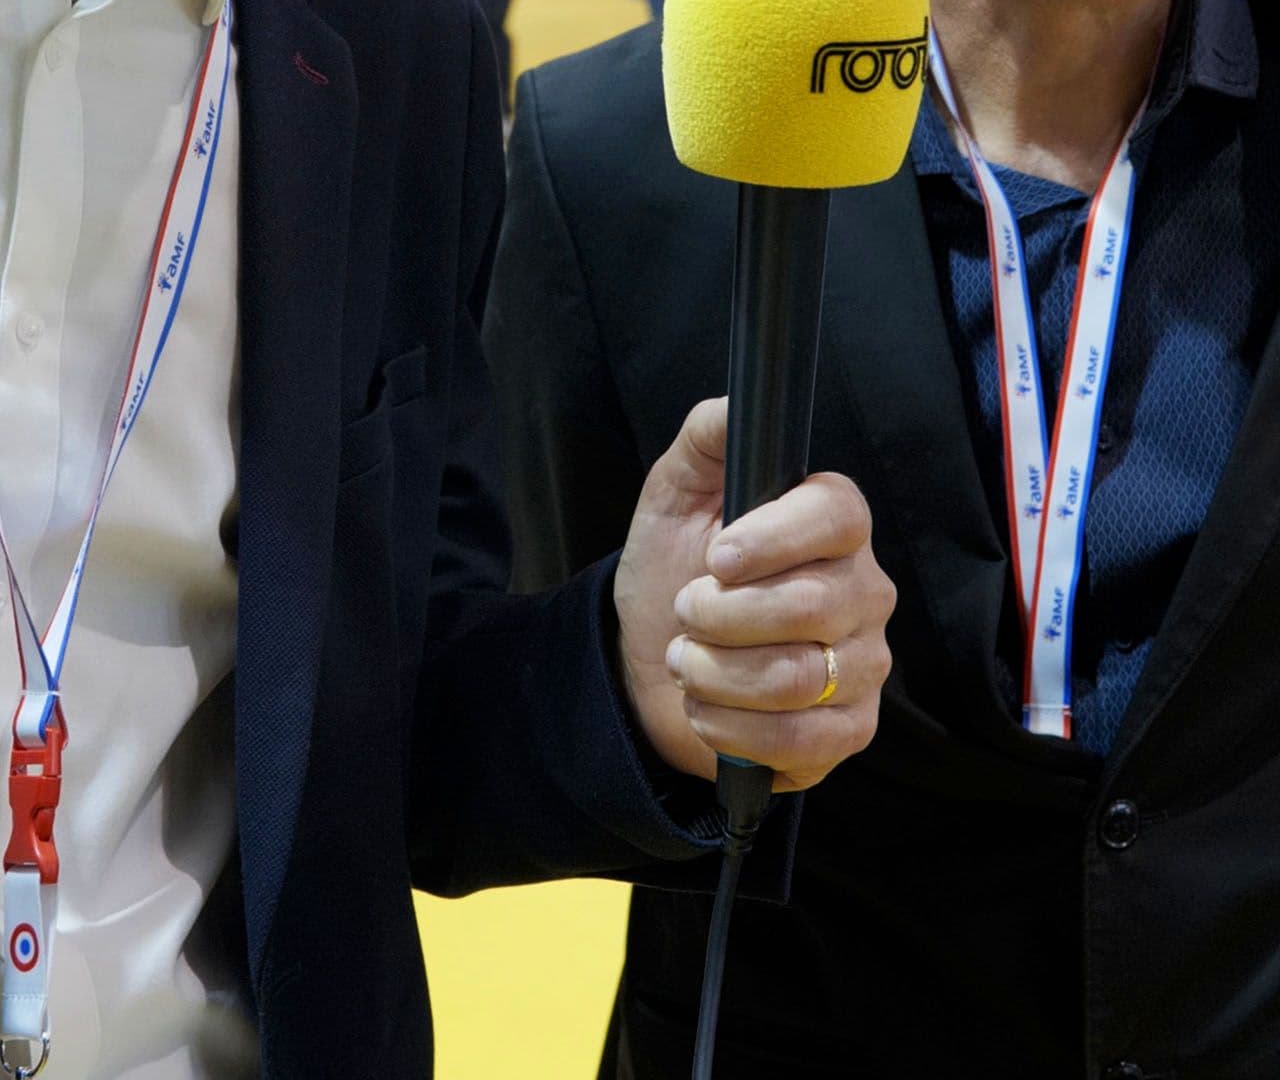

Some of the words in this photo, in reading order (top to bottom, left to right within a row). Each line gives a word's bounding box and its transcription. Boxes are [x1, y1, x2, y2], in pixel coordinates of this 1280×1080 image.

[167, 231, 185, 278] aMF
[1103, 226, 1118, 265] aMF
[1086, 345, 1099, 384] aMF
[1028, 464, 1042, 503] aMF
[1066, 466, 1081, 505] aMF
[1052, 586, 1064, 626] aMF
